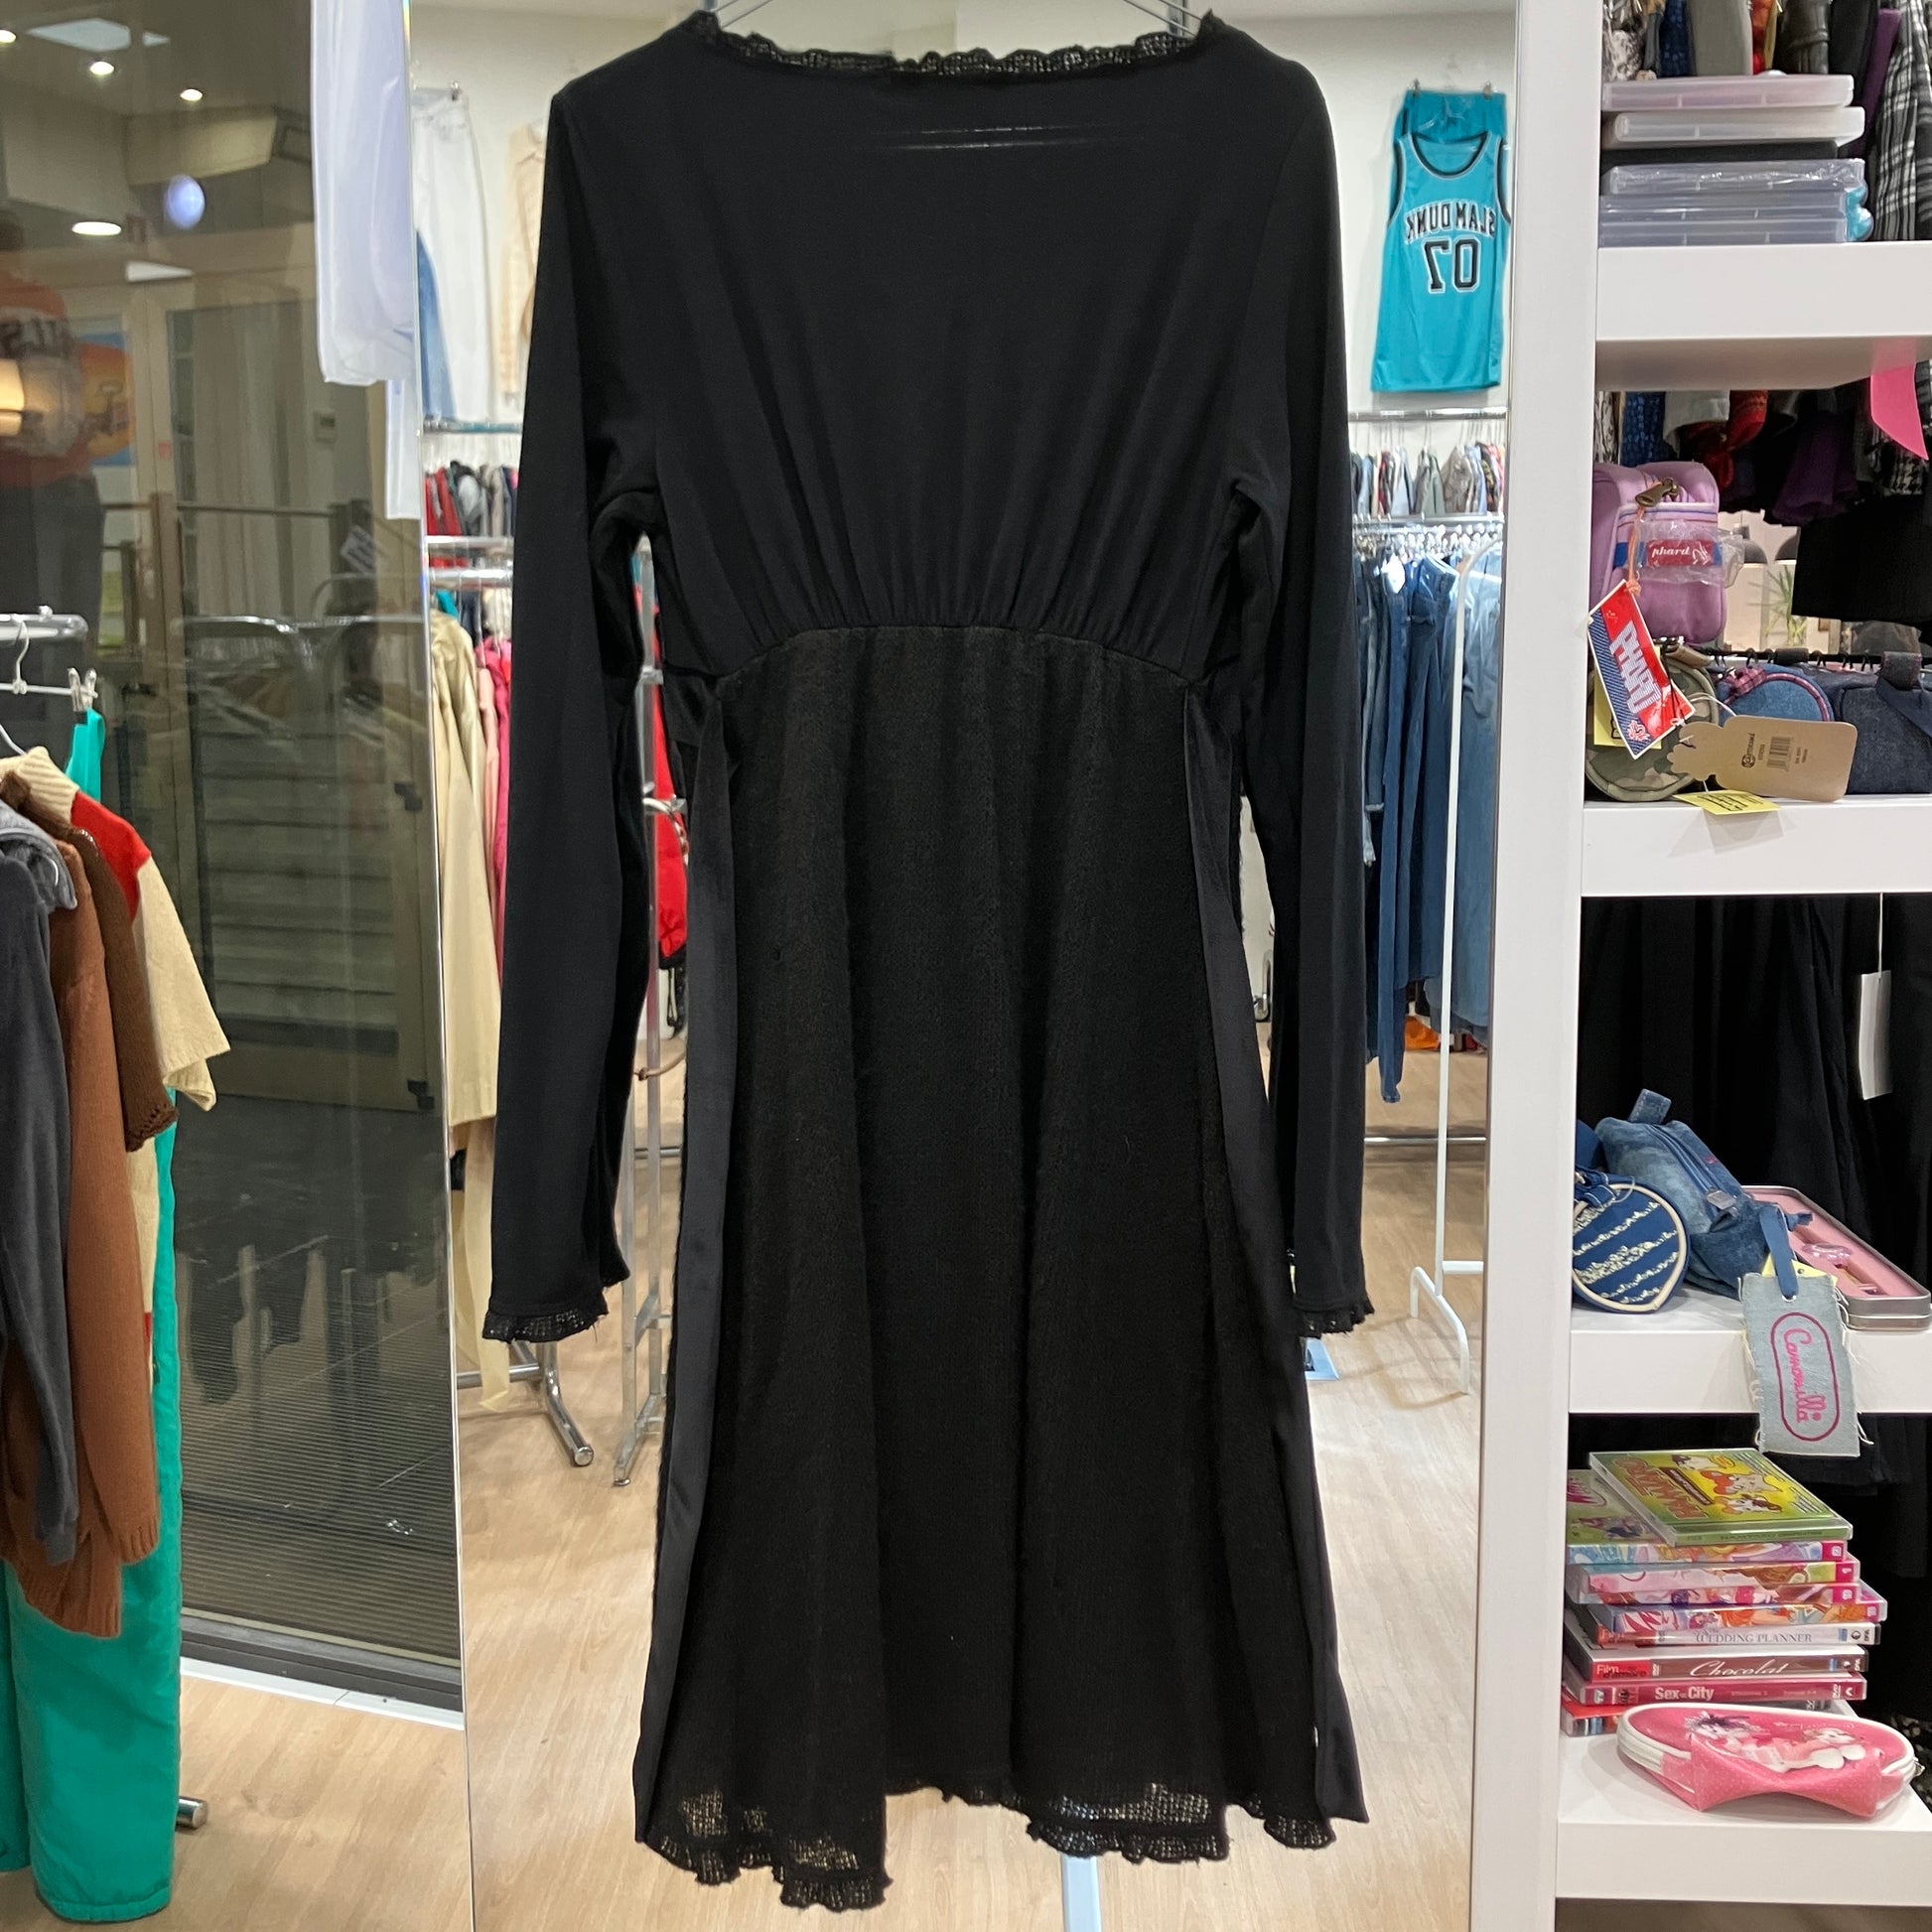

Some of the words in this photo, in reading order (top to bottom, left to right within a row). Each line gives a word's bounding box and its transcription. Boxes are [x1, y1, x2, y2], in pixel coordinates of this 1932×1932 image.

[1651, 546, 1691, 558] phard
[1609, 620, 1663, 714] PHARD
[1757, 1633, 1813, 1643] PLANNER
[1596, 1664, 1620, 1675] Film
[1690, 1659, 1789, 1677] Chocolat
[1655, 1687, 1679, 1701] Sex
[1688, 1686, 1715, 1702] City
